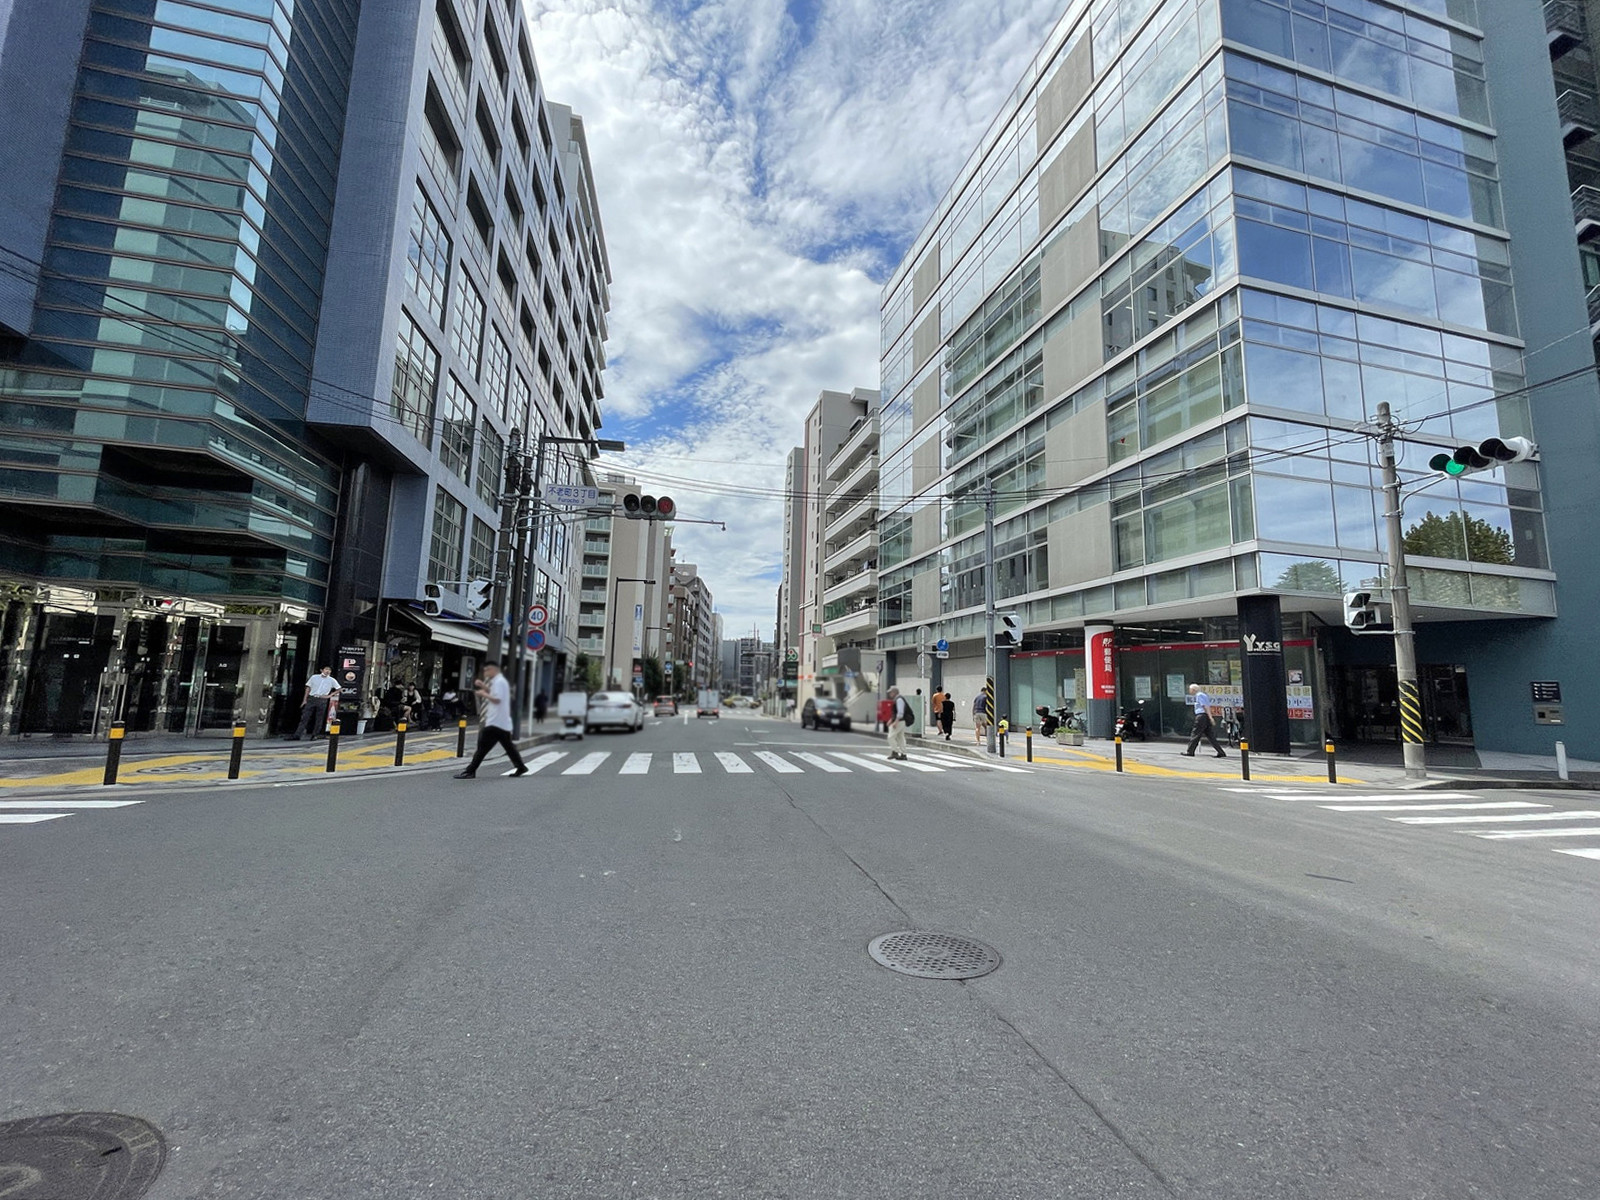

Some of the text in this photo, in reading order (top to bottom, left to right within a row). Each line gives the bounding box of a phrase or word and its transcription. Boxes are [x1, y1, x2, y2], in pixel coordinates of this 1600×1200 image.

[548, 486, 596, 499] 不老町3丁目
[531, 610, 543, 621] 40
[1104, 647, 1113, 672] 郵便局
